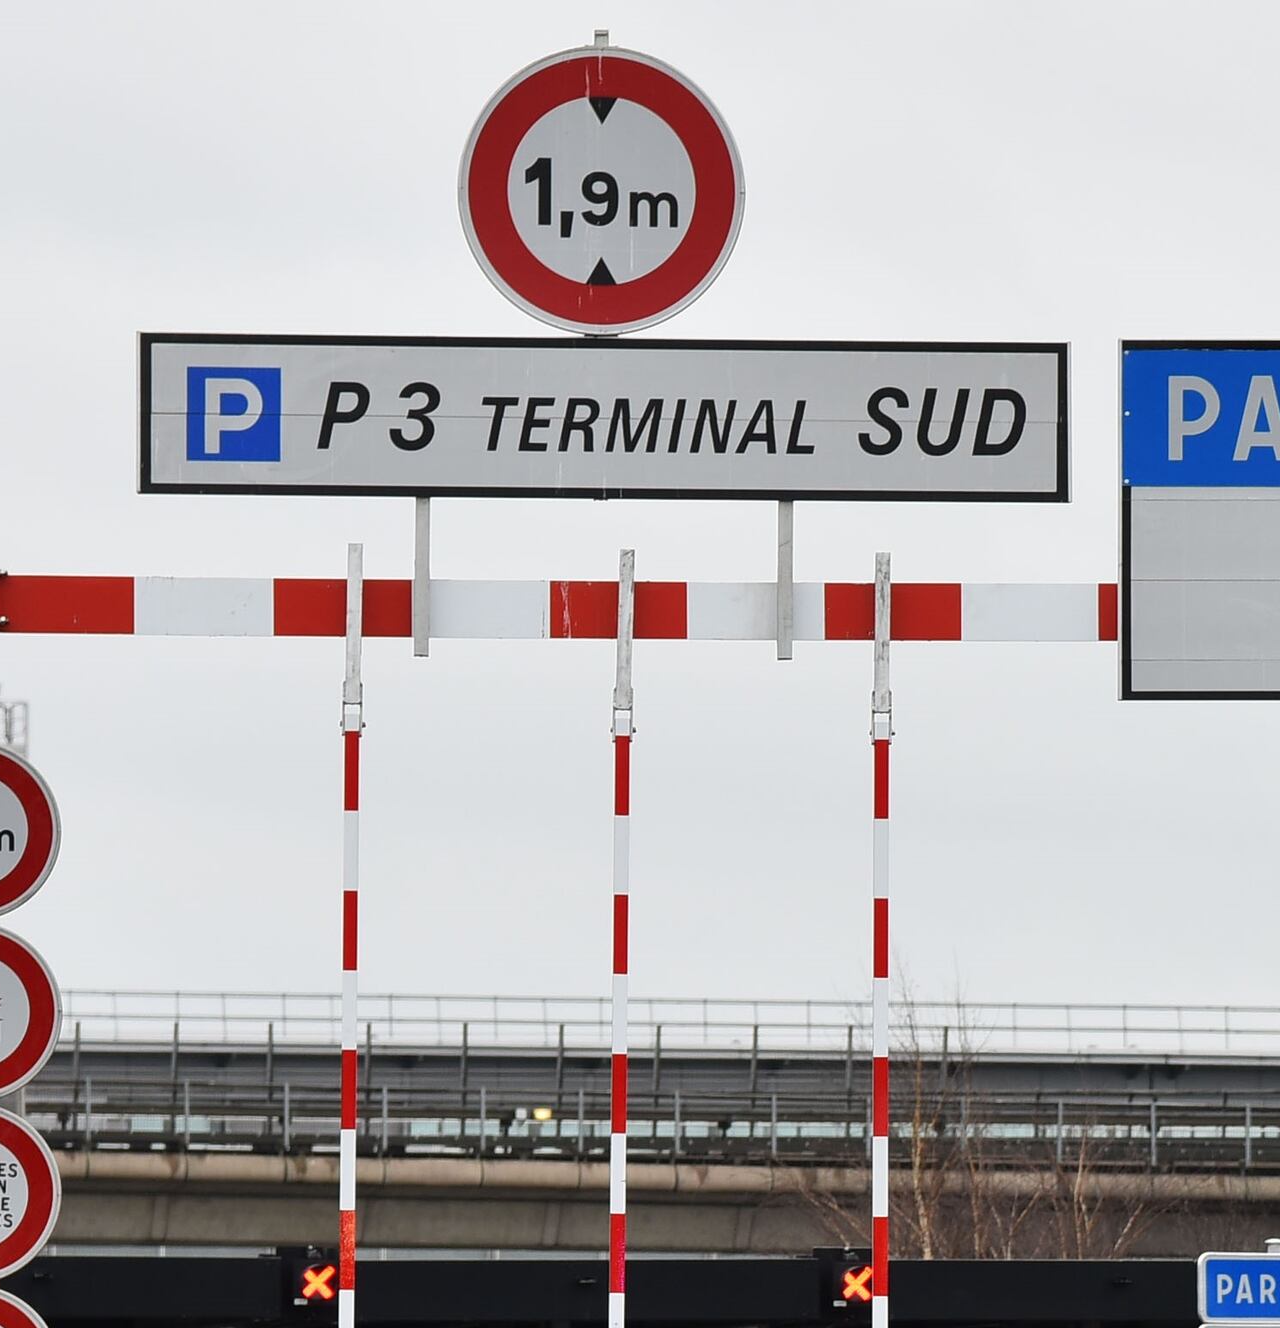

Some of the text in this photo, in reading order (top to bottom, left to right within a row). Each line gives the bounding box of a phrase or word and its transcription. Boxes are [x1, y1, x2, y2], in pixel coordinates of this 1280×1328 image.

[524, 157, 679, 238] 1,9m
[317, 381, 371, 450] P
[389, 381, 441, 452] 3
[481, 396, 816, 456] TERMINAL
[858, 386, 1027, 458] SUD
